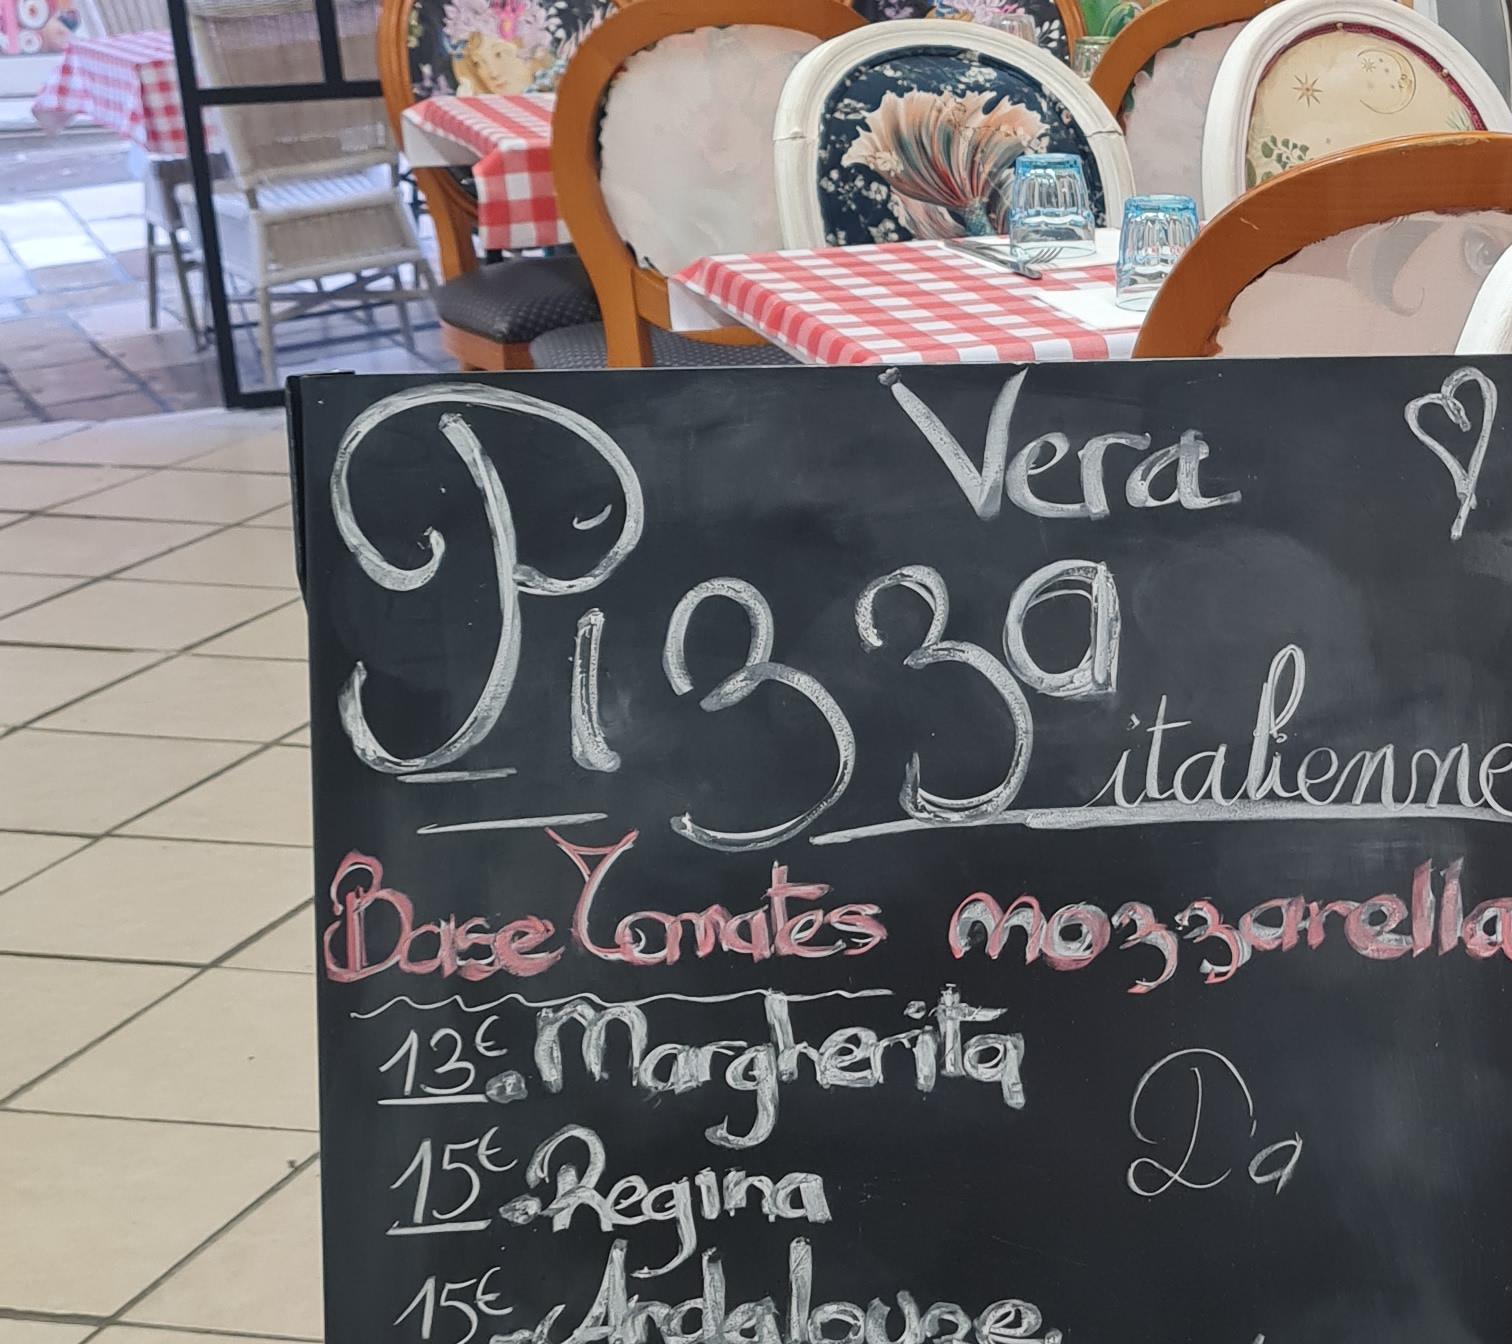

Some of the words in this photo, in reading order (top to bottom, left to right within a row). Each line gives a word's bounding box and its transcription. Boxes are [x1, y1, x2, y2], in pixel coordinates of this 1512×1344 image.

[878, 367, 1242, 519] Vera
[330, 383, 1122, 853] Pizza
[323, 850, 563, 983] Base
[534, 984, 1027, 1149] Margherita
[1127, 1048, 1303, 1197] Da
[526, 1124, 833, 1279] Regina
